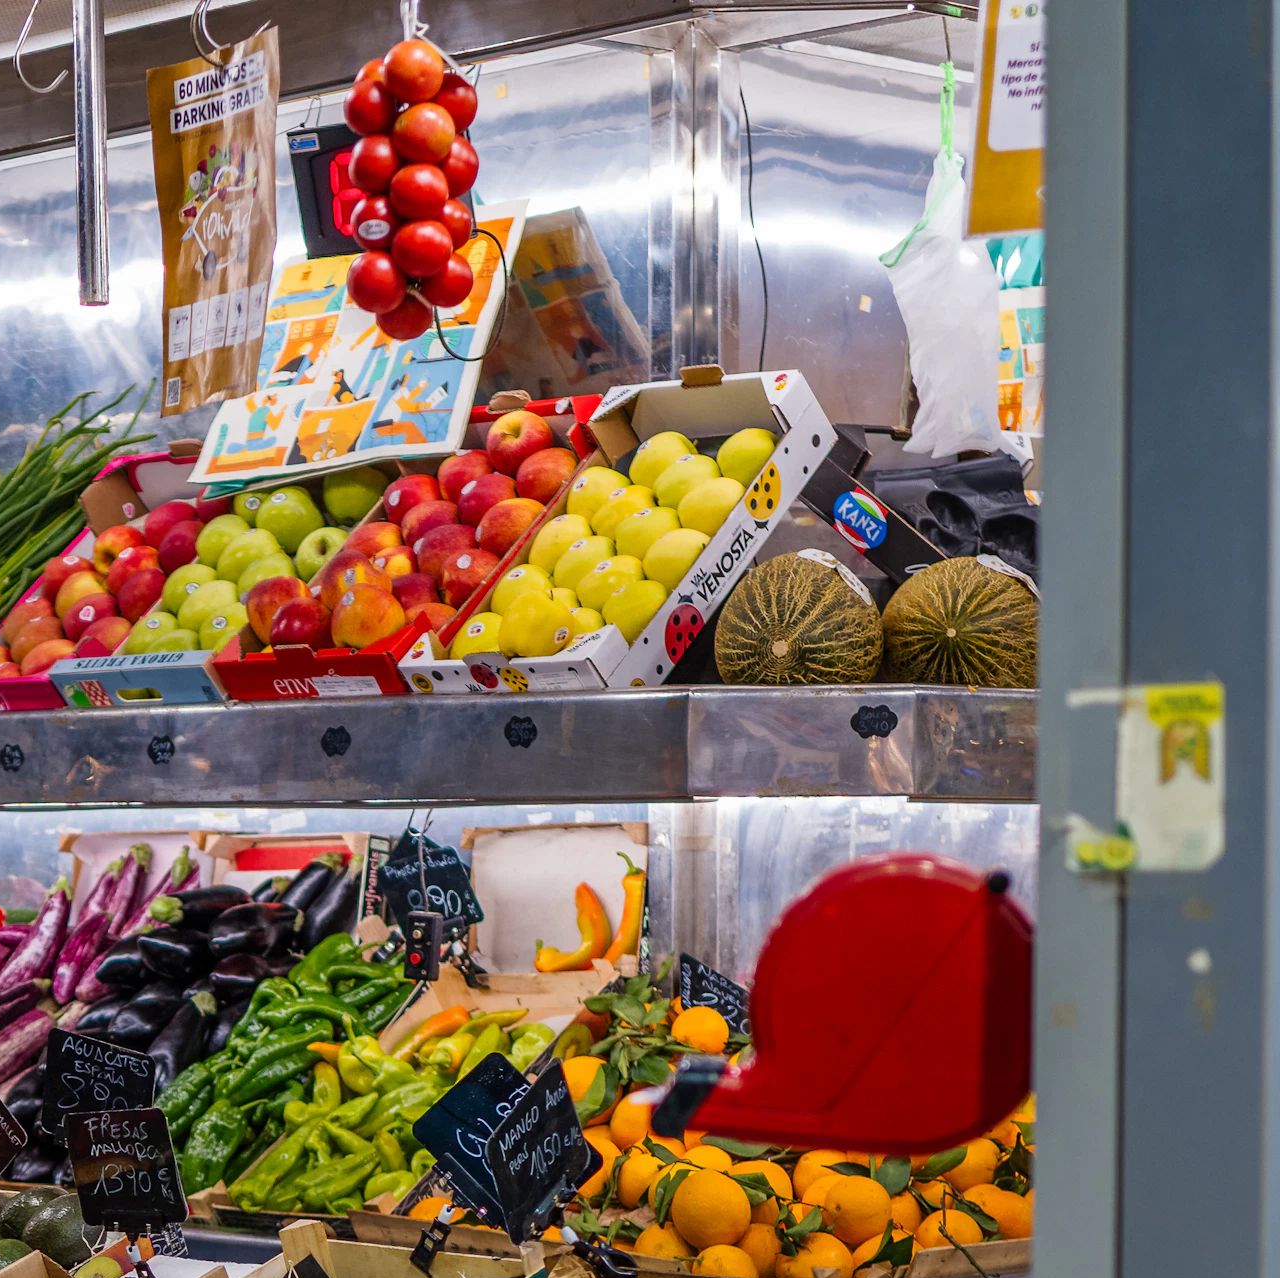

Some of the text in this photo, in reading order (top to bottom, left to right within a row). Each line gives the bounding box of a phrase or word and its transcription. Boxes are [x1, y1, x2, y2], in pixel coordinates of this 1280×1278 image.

[1007, 58, 1043, 69] Merca
[179, 80, 193, 100] 60
[1001, 72, 1038, 87] tipo de
[229, 83, 265, 112] GRATIS
[1008, 88, 1023, 98] No
[696, 527, 755, 603] VENOSTA
[690, 567, 708, 588] VAL
[74, 652, 184, 670] GIRONA FRUITS
[273, 677, 316, 695] env
[365, 850, 383, 916] arifrancis
[62, 1036, 150, 1078] AGUACATES
[74, 1060, 126, 1087] ESPAÑA
[84, 1113, 149, 1142] FRESAS
[499, 1105, 540, 1162] MANGO
[90, 1143, 161, 1161] MALLORCA
